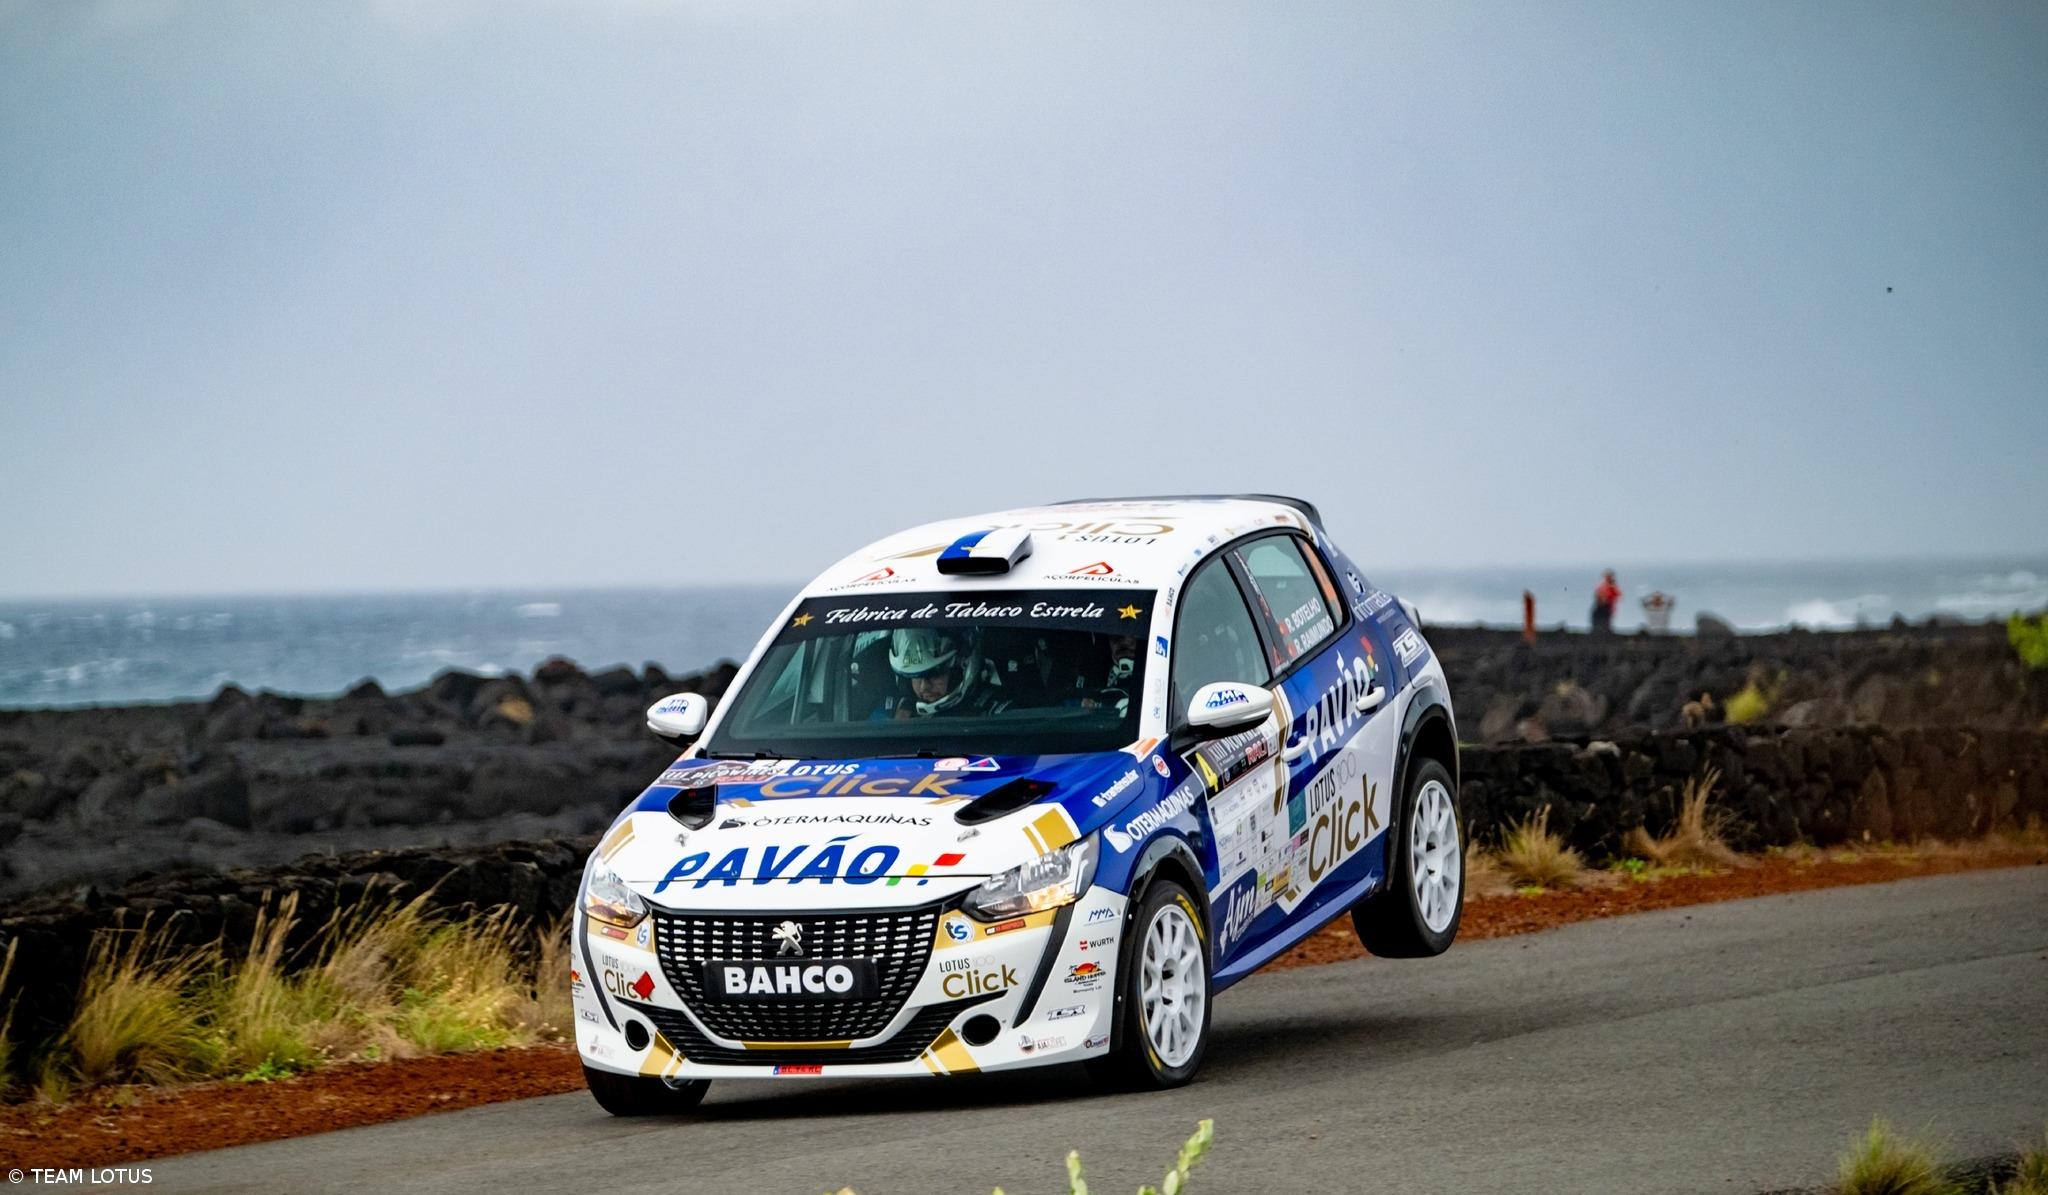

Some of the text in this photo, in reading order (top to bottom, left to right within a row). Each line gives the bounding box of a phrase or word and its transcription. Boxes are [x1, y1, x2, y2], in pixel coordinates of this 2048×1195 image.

[825, 602, 1106, 625] Fábrica de Tabaco Estrela
[1291, 596, 1321, 630] BOTELHO
[1299, 614, 1335, 651] RAIMUNDO
[760, 773, 963, 798] Click
[779, 763, 861, 777] LOTUS
[1195, 752, 1219, 793] 4
[1309, 768, 1336, 817] LOTUS
[1308, 772, 1380, 883] Click
[602, 954, 619, 967] LOTUS
[940, 957, 971, 973] LOTUS
[604, 969, 653, 1002] Clic
[724, 965, 854, 994] BAHCO
[943, 964, 1019, 998] Click
